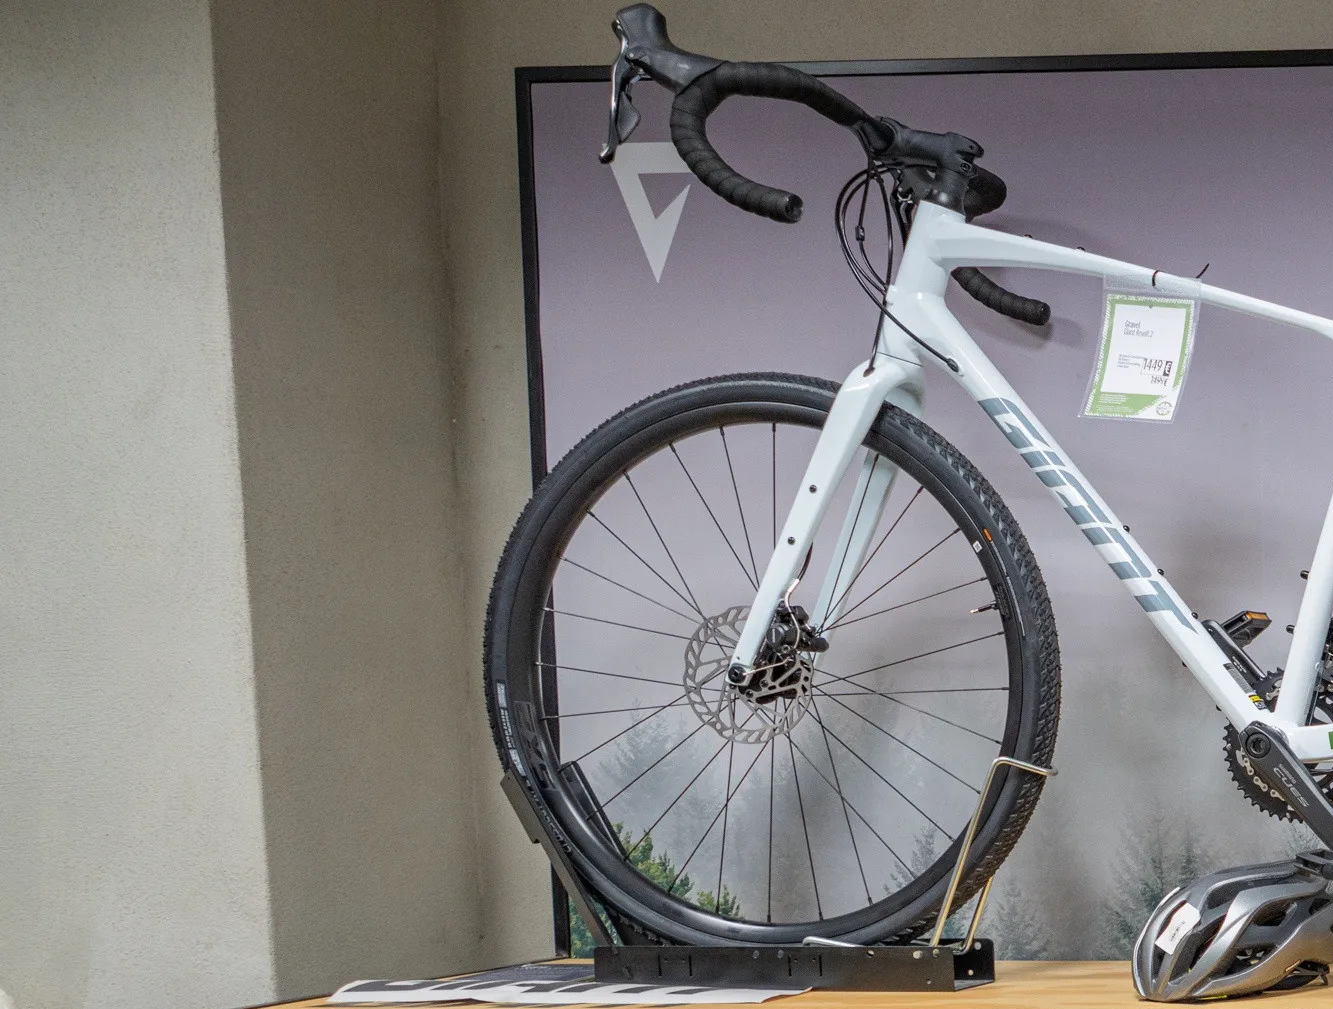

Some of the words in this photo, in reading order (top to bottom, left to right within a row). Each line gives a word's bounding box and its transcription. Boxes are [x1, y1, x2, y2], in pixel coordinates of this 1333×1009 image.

[1124, 319, 1141, 328] Gravel
[1143, 358, 1163, 372] 1449
[977, 397, 1199, 635] GIANT
[1273, 766, 1309, 807] CUES
